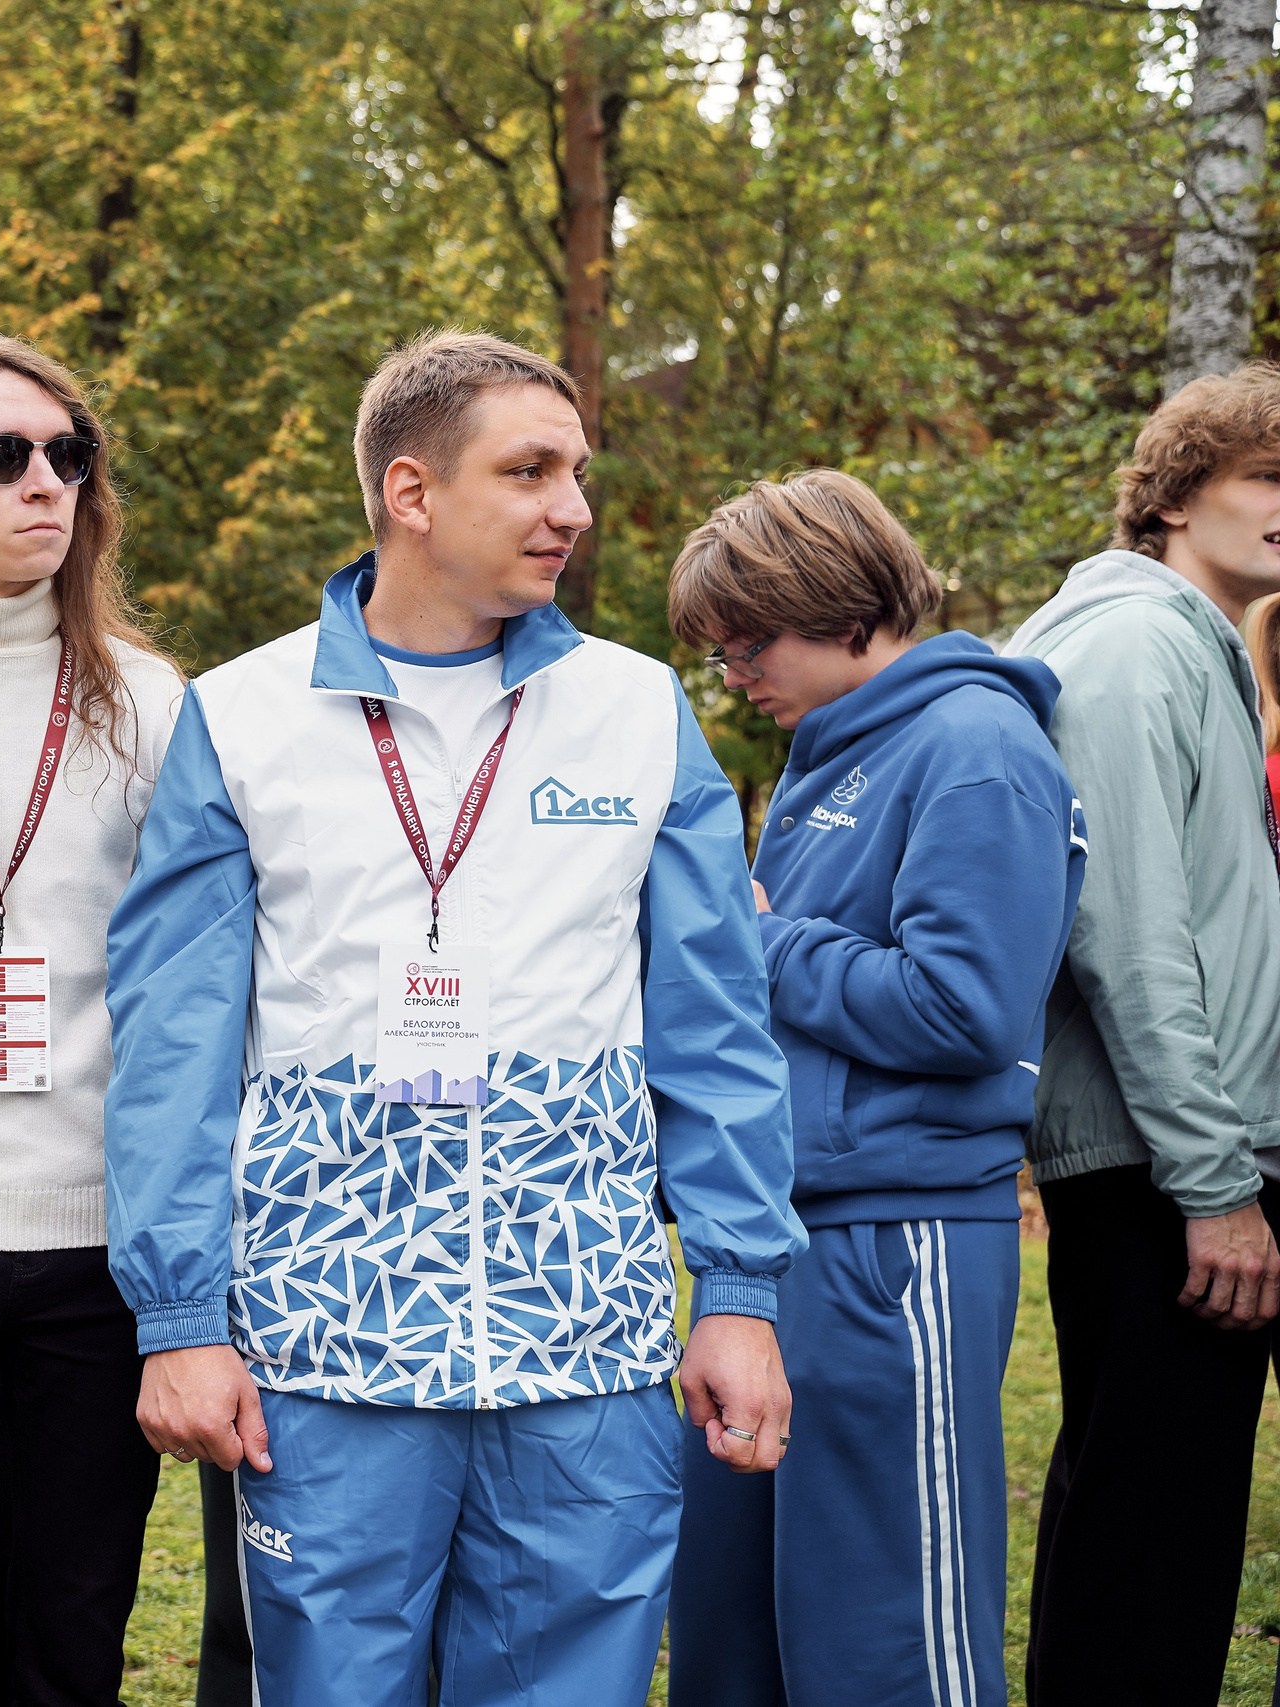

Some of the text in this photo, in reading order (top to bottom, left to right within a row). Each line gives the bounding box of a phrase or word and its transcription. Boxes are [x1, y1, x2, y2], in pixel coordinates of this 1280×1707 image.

[58, 697, 67, 705] Я
[387, 760, 399, 769] Я
[15, 791, 42, 858] ФУНДАМЕНТ
[38, 747, 57, 792] ГОРОДА
[391, 769, 422, 837] ФУНДАМЕНТ
[448, 742, 504, 863] Я ФУНДАМЕНТ ГОРОДА
[405, 977, 460, 996] XVIII
[404, 996, 460, 1007] СТРОЙСЛЁТ
[403, 1019, 461, 1030] БЕЛОКУРОВ
[384, 1030, 480, 1039] АЛЕКСАНДР ВИКТОРОВИЧ
